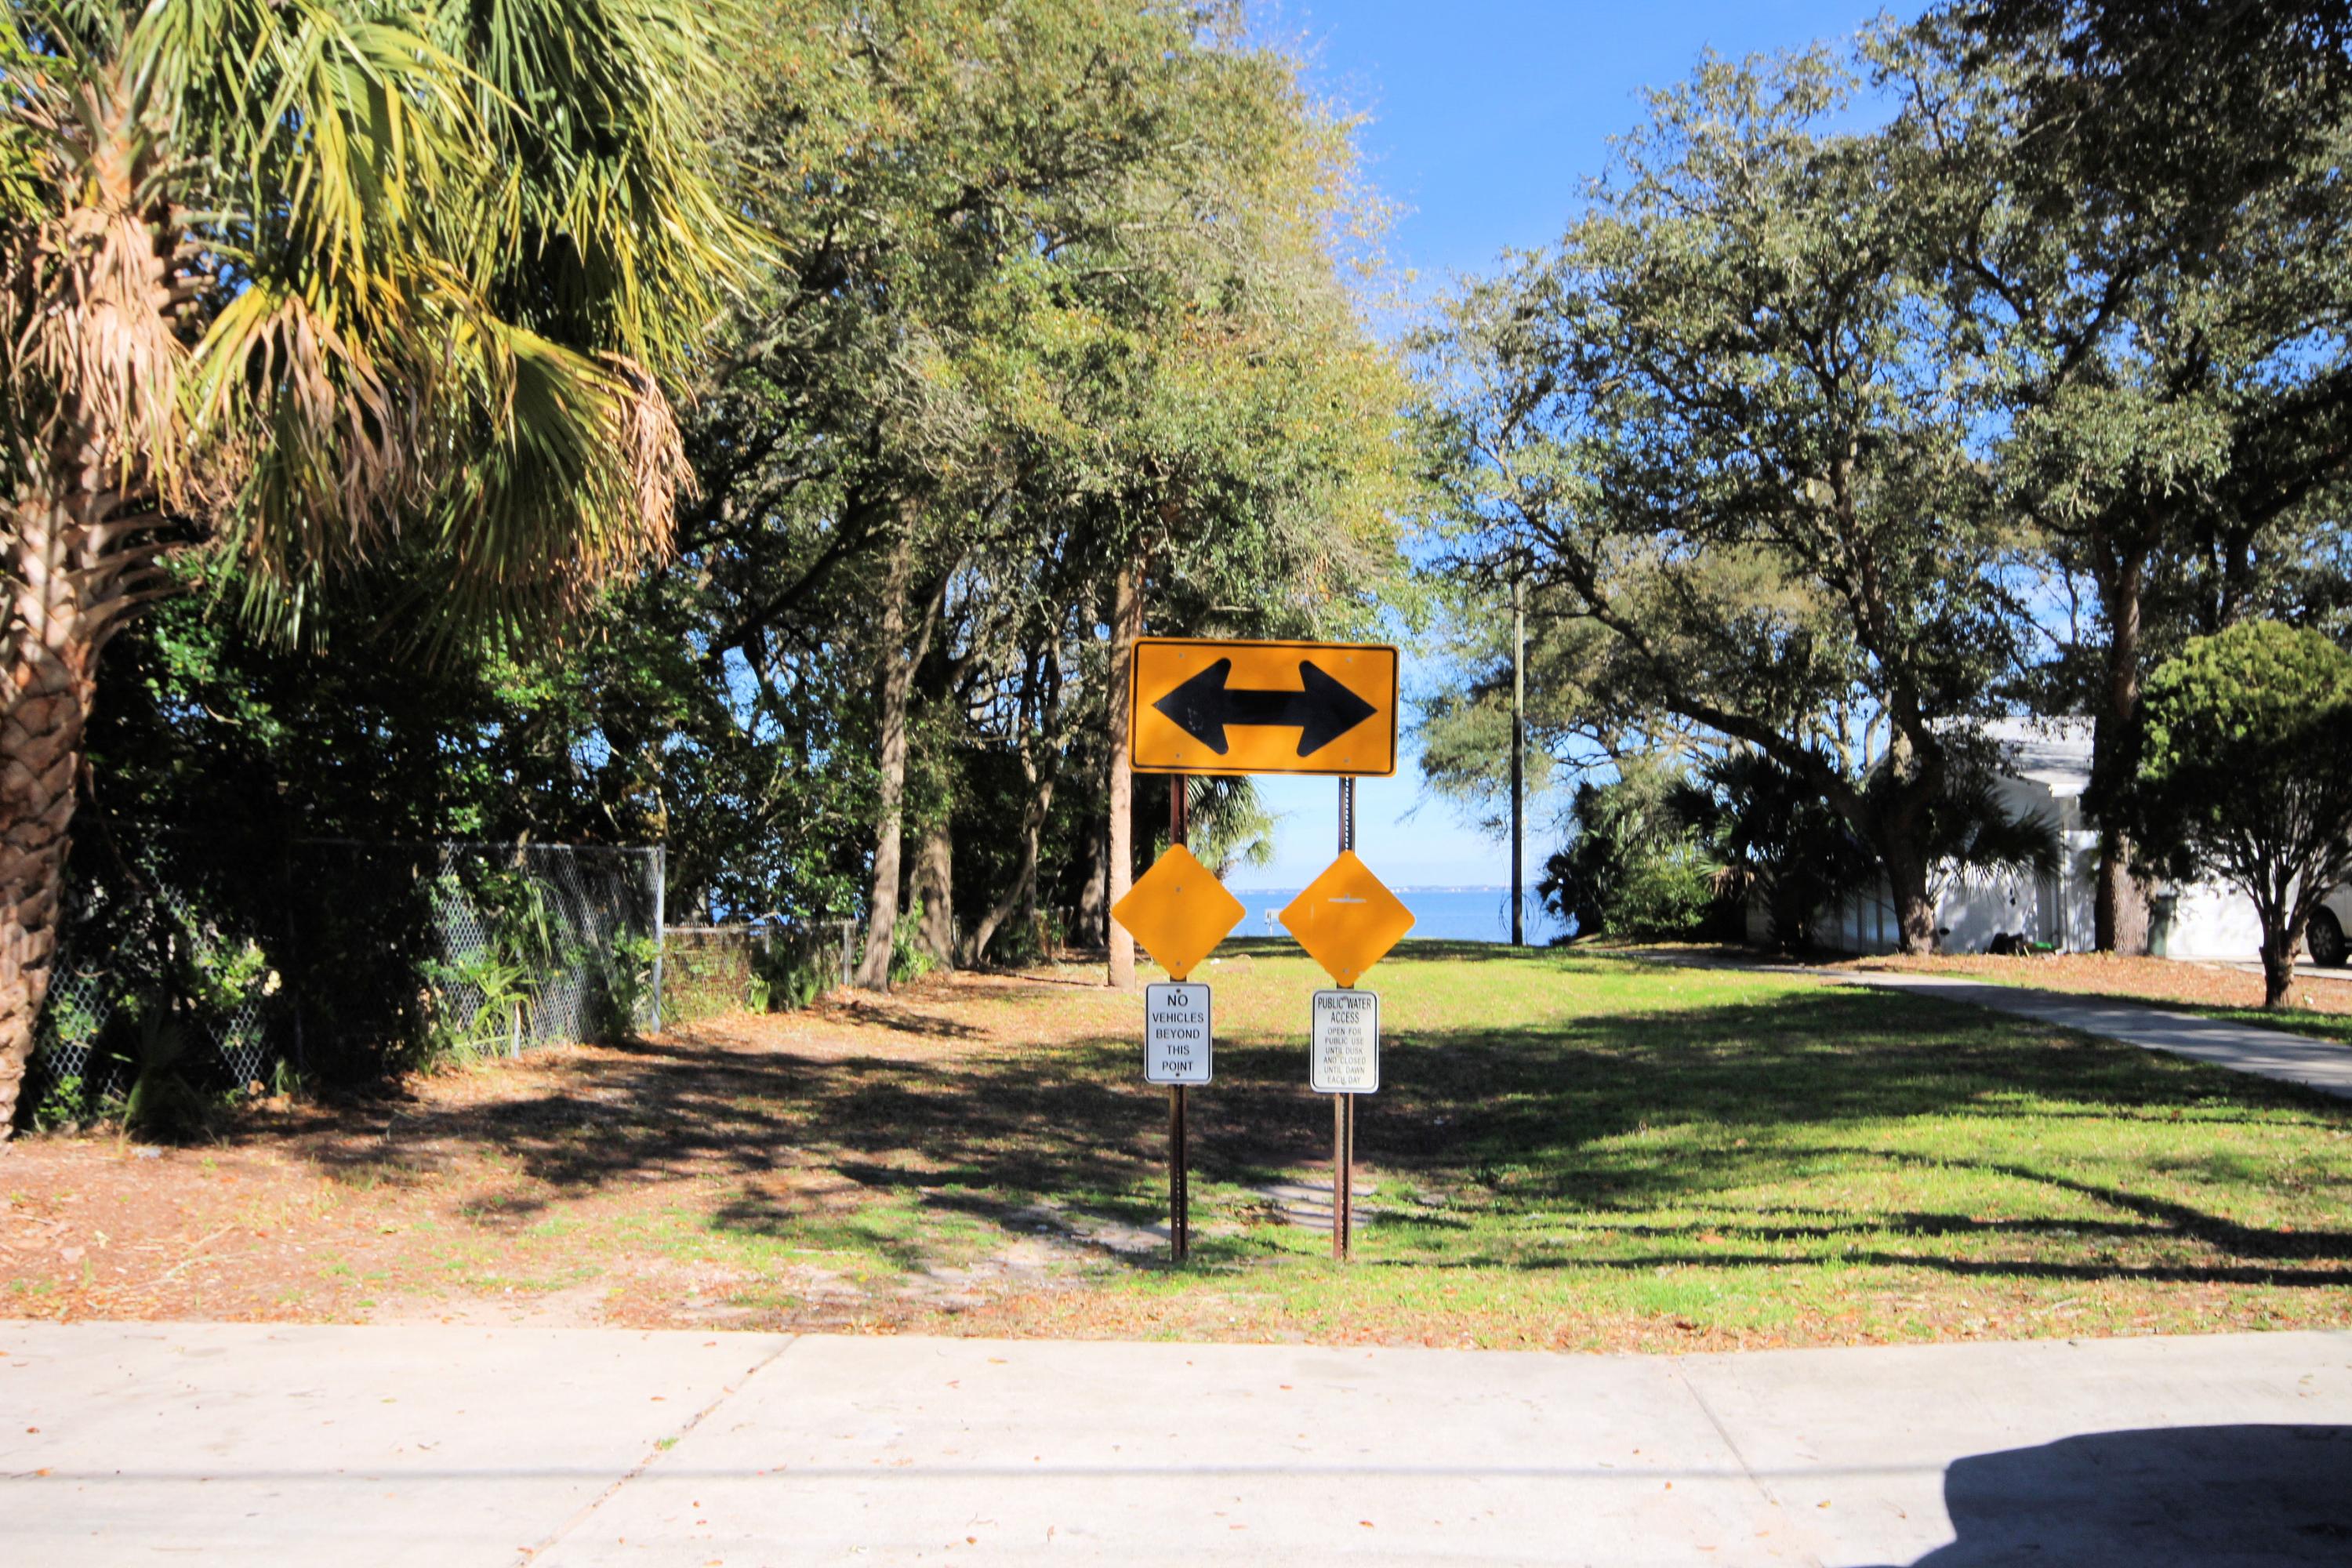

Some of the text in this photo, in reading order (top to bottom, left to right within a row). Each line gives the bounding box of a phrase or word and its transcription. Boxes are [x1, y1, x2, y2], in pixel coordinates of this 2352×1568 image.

[1167, 994, 1189, 1007] NO
[1318, 996, 1372, 1010] PUBLIC WATER
[1152, 1012, 1204, 1023] VEHICLES
[1330, 1011, 1359, 1024] ACCESS
[1156, 1029, 1200, 1040] BEYOND
[1167, 1045, 1190, 1055] THIS
[1345, 1047, 1363, 1055] DUSK
[1340, 1056, 1367, 1065] CLOSED
[1162, 1061, 1193, 1071] POINT
[1324, 1065, 1342, 1074] UNTIL
